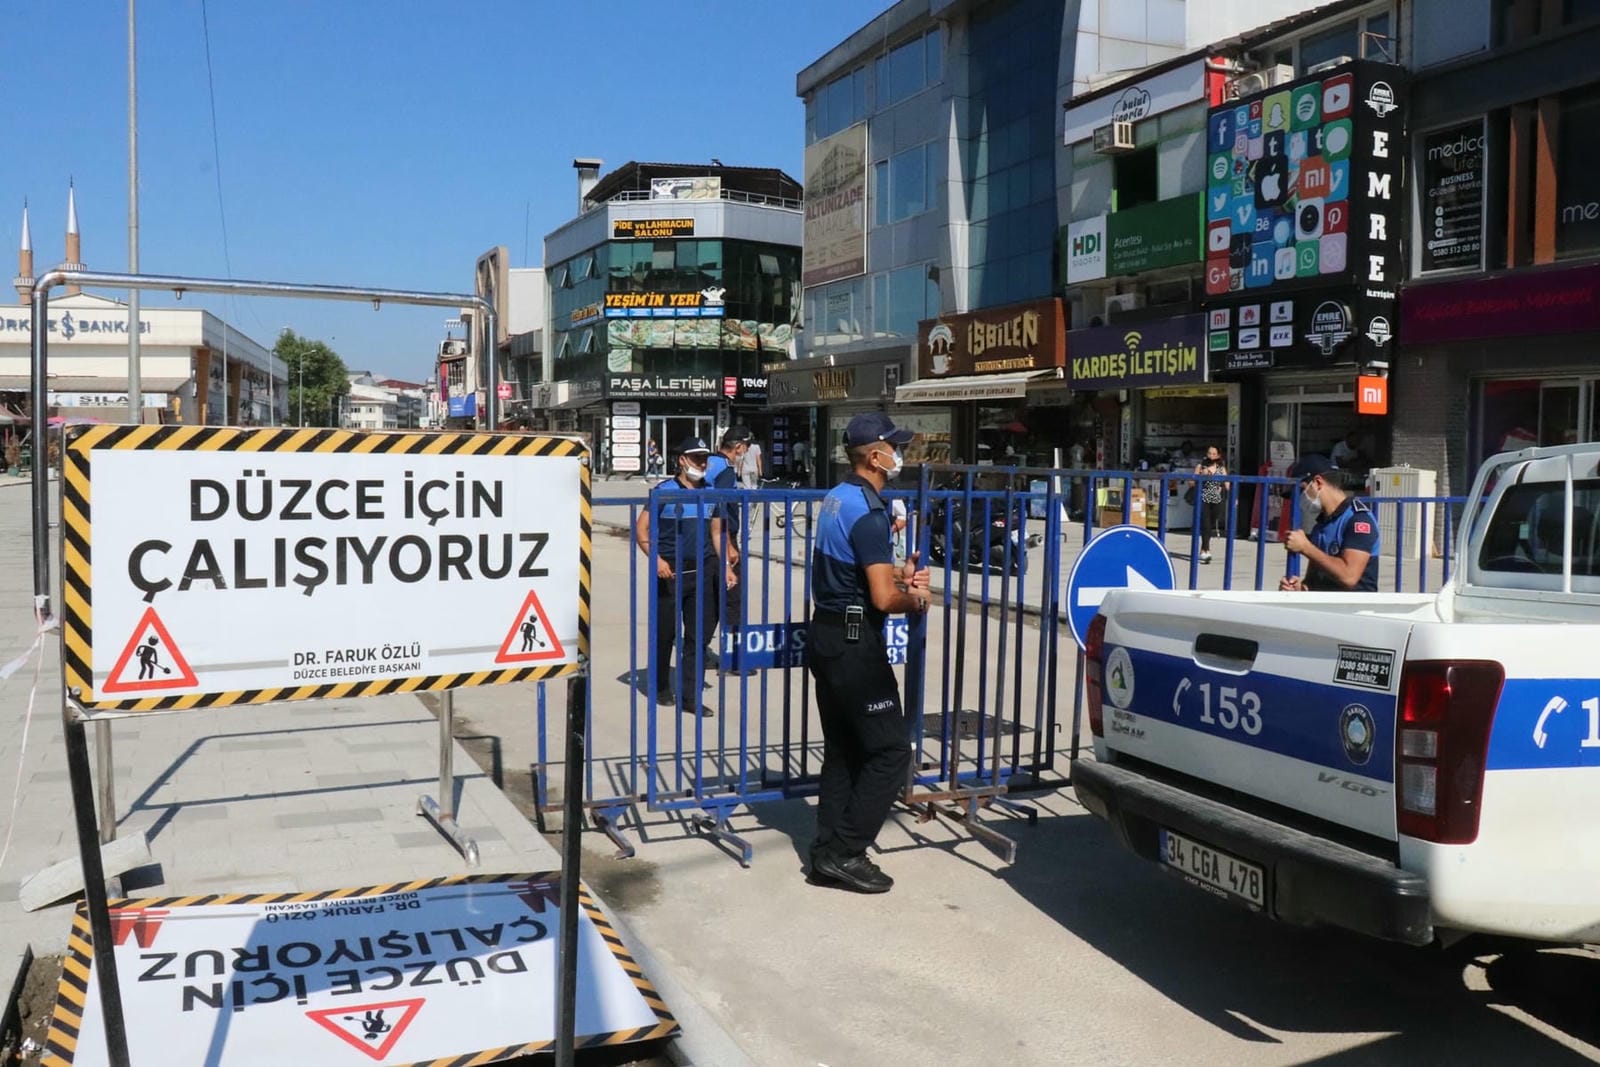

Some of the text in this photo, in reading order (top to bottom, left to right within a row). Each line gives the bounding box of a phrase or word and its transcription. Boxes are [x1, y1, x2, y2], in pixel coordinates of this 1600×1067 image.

[1440, 171, 1474, 186] BUSINESS
[614, 221, 633, 231] PİDE
[646, 221, 693, 230] LAHMACUN
[634, 230, 673, 238] SALONU
[1072, 231, 1101, 257] HDI
[669, 291, 701, 306] YERİ
[79, 320, 150, 334] BANKSI
[1073, 341, 1197, 379] KARDEŞ İLETİŞİM
[610, 378, 652, 391] PAŞA
[655, 375, 716, 392] İLETİŞİM
[189, 469, 503, 526] DÜZCE İÇİN
[127, 532, 550, 604] ÇALIŞIYORUZ
[721, 629, 808, 654] POLS
[293, 642, 421, 666] DR. FARUK ÖZLÜ
[293, 661, 421, 680] DÜZCE BELEDİYE BAŞKANI
[867, 700, 894, 712] ZABITA
[1199, 682, 1262, 736] 153
[1168, 835, 1259, 900] 34 CGA 478
[266, 900, 421, 924] DR. FARUK ÖZLÜ
[137, 913, 549, 984] ÇALIŞIYORUZ
[181, 949, 528, 1014] DÜZCE İÇİN
